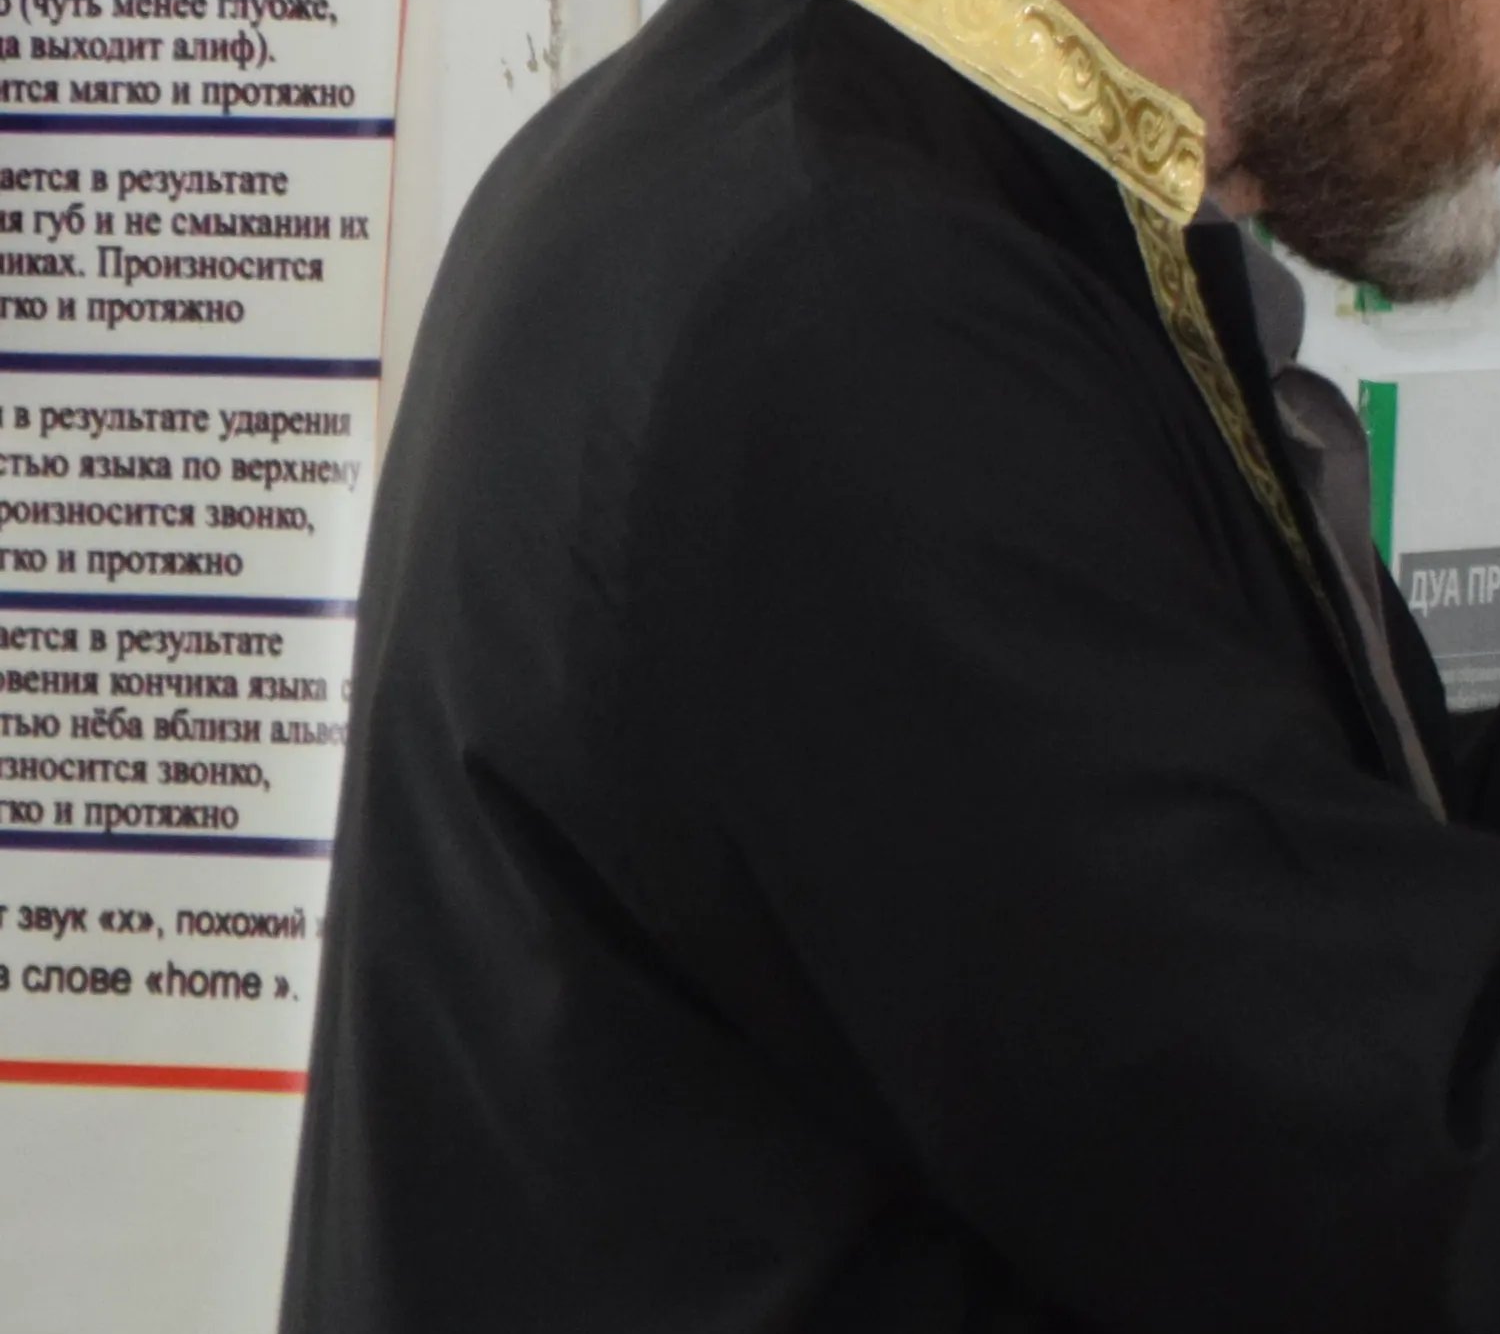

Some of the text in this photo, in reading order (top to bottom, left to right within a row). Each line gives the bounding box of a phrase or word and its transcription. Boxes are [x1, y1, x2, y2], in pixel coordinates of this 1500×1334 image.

[29, 35, 164, 63] выходит
[173, 28, 275, 69] алиф).
[69, 80, 162, 106] мягко
[171, 81, 191, 106] и
[202, 82, 355, 116] протяжно
[90, 169, 109, 193] в
[117, 168, 289, 203] результате
[32, 201, 86, 244] губ
[94, 211, 115, 236] и
[124, 211, 163, 237] не
[170, 212, 331, 240] смыкании
[339, 215, 370, 241] их
[96, 244, 324, 288] Произносится
[57, 296, 77, 322] и
[86, 297, 245, 331] протяжно
[13, 405, 351, 445] в результате ударения
[78, 454, 173, 481] языка
[182, 456, 222, 482] по
[231, 458, 360, 492] верхнему
[205, 503, 315, 534] звонко,
[57, 549, 77, 574] и
[86, 549, 244, 583] протяжно
[1409, 570, 1462, 617] ДУА
[89, 628, 108, 653] в
[116, 628, 284, 664] результате
[109, 671, 239, 699] кончика
[247, 675, 327, 702] языка
[70, 705, 144, 741] нёба
[153, 707, 262, 744] вблизи
[157, 759, 271, 791] звонко,
[53, 800, 74, 826] и
[84, 802, 240, 835] протяжно
[17, 904, 88, 941] звук
[175, 908, 306, 939] похожий
[21, 963, 133, 996] слове
